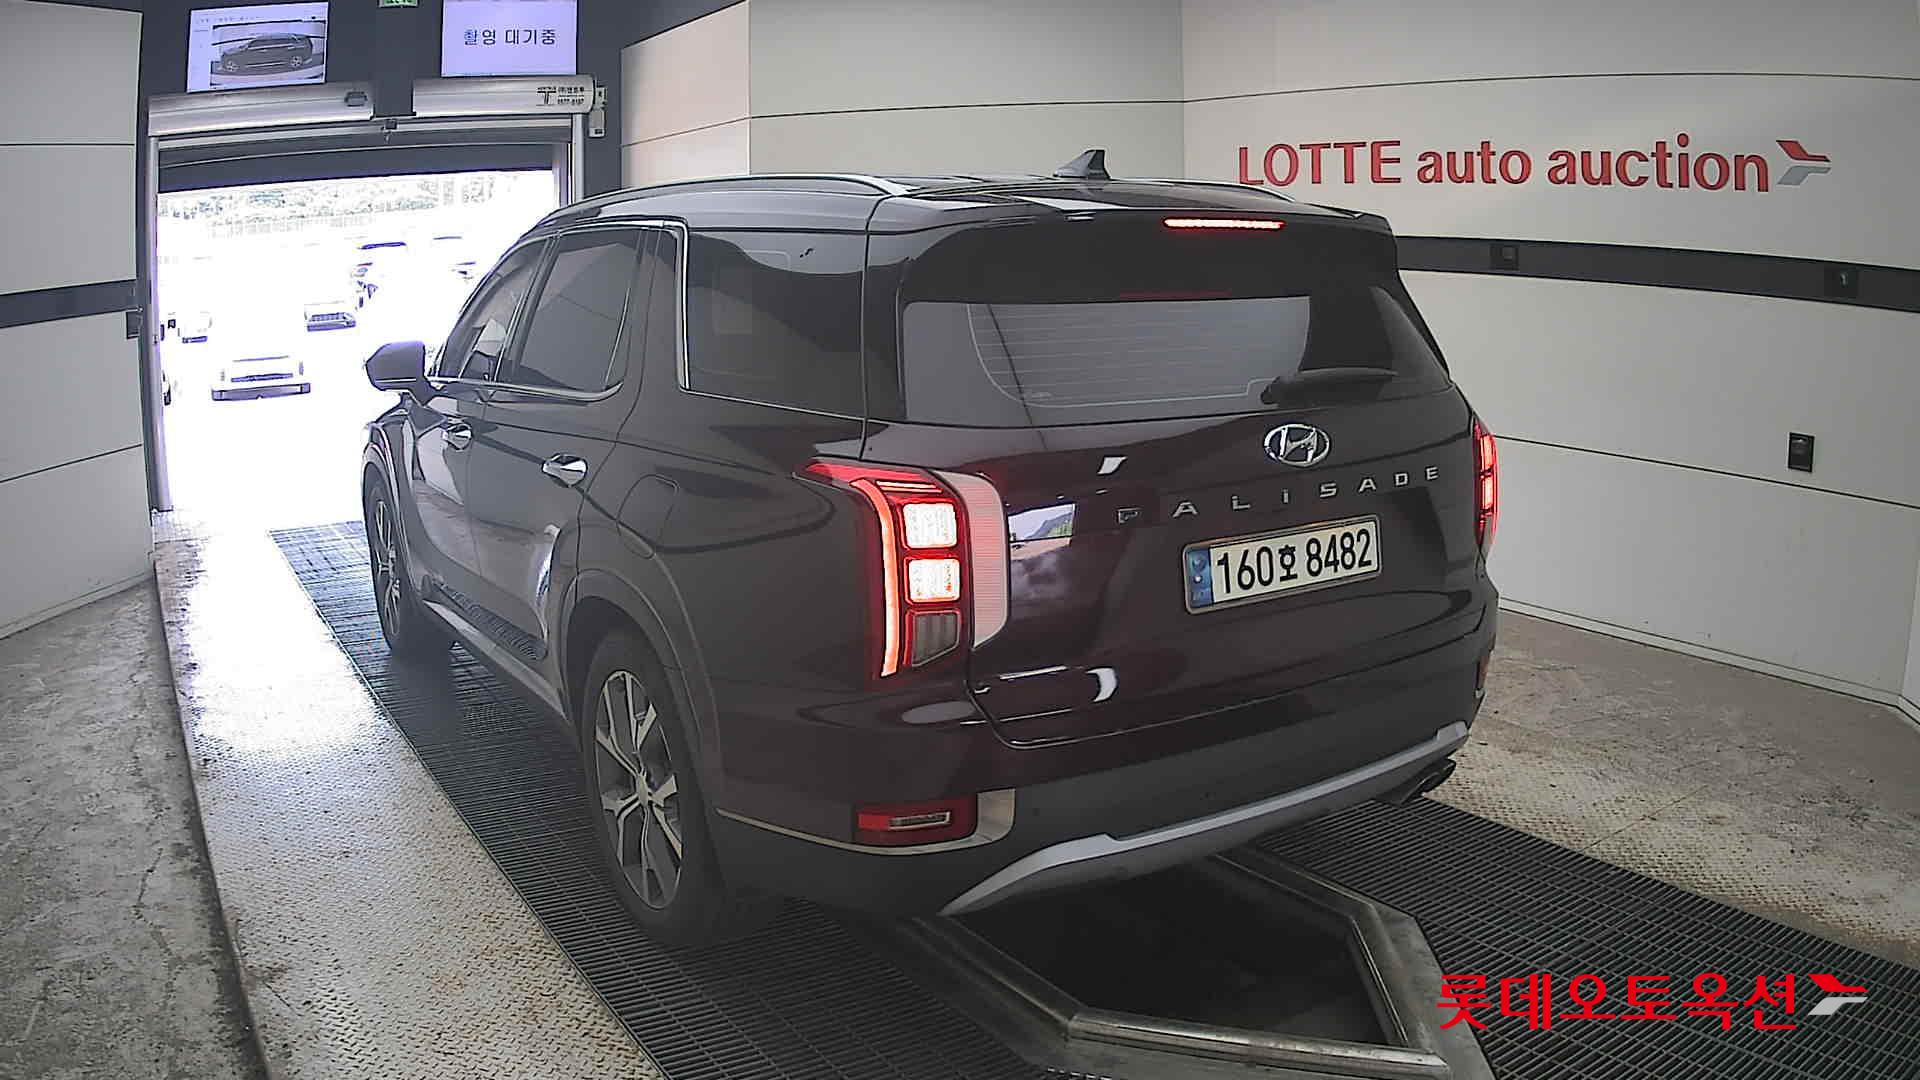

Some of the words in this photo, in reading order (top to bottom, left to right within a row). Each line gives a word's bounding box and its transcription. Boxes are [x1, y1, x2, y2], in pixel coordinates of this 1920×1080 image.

[505, 29, 557, 45] 대기중
[1238, 140, 1401, 187] LOTTE
[1417, 141, 1532, 184] auto
[1548, 133, 1769, 192] auction
[1117, 466, 1439, 524] PALISADE
